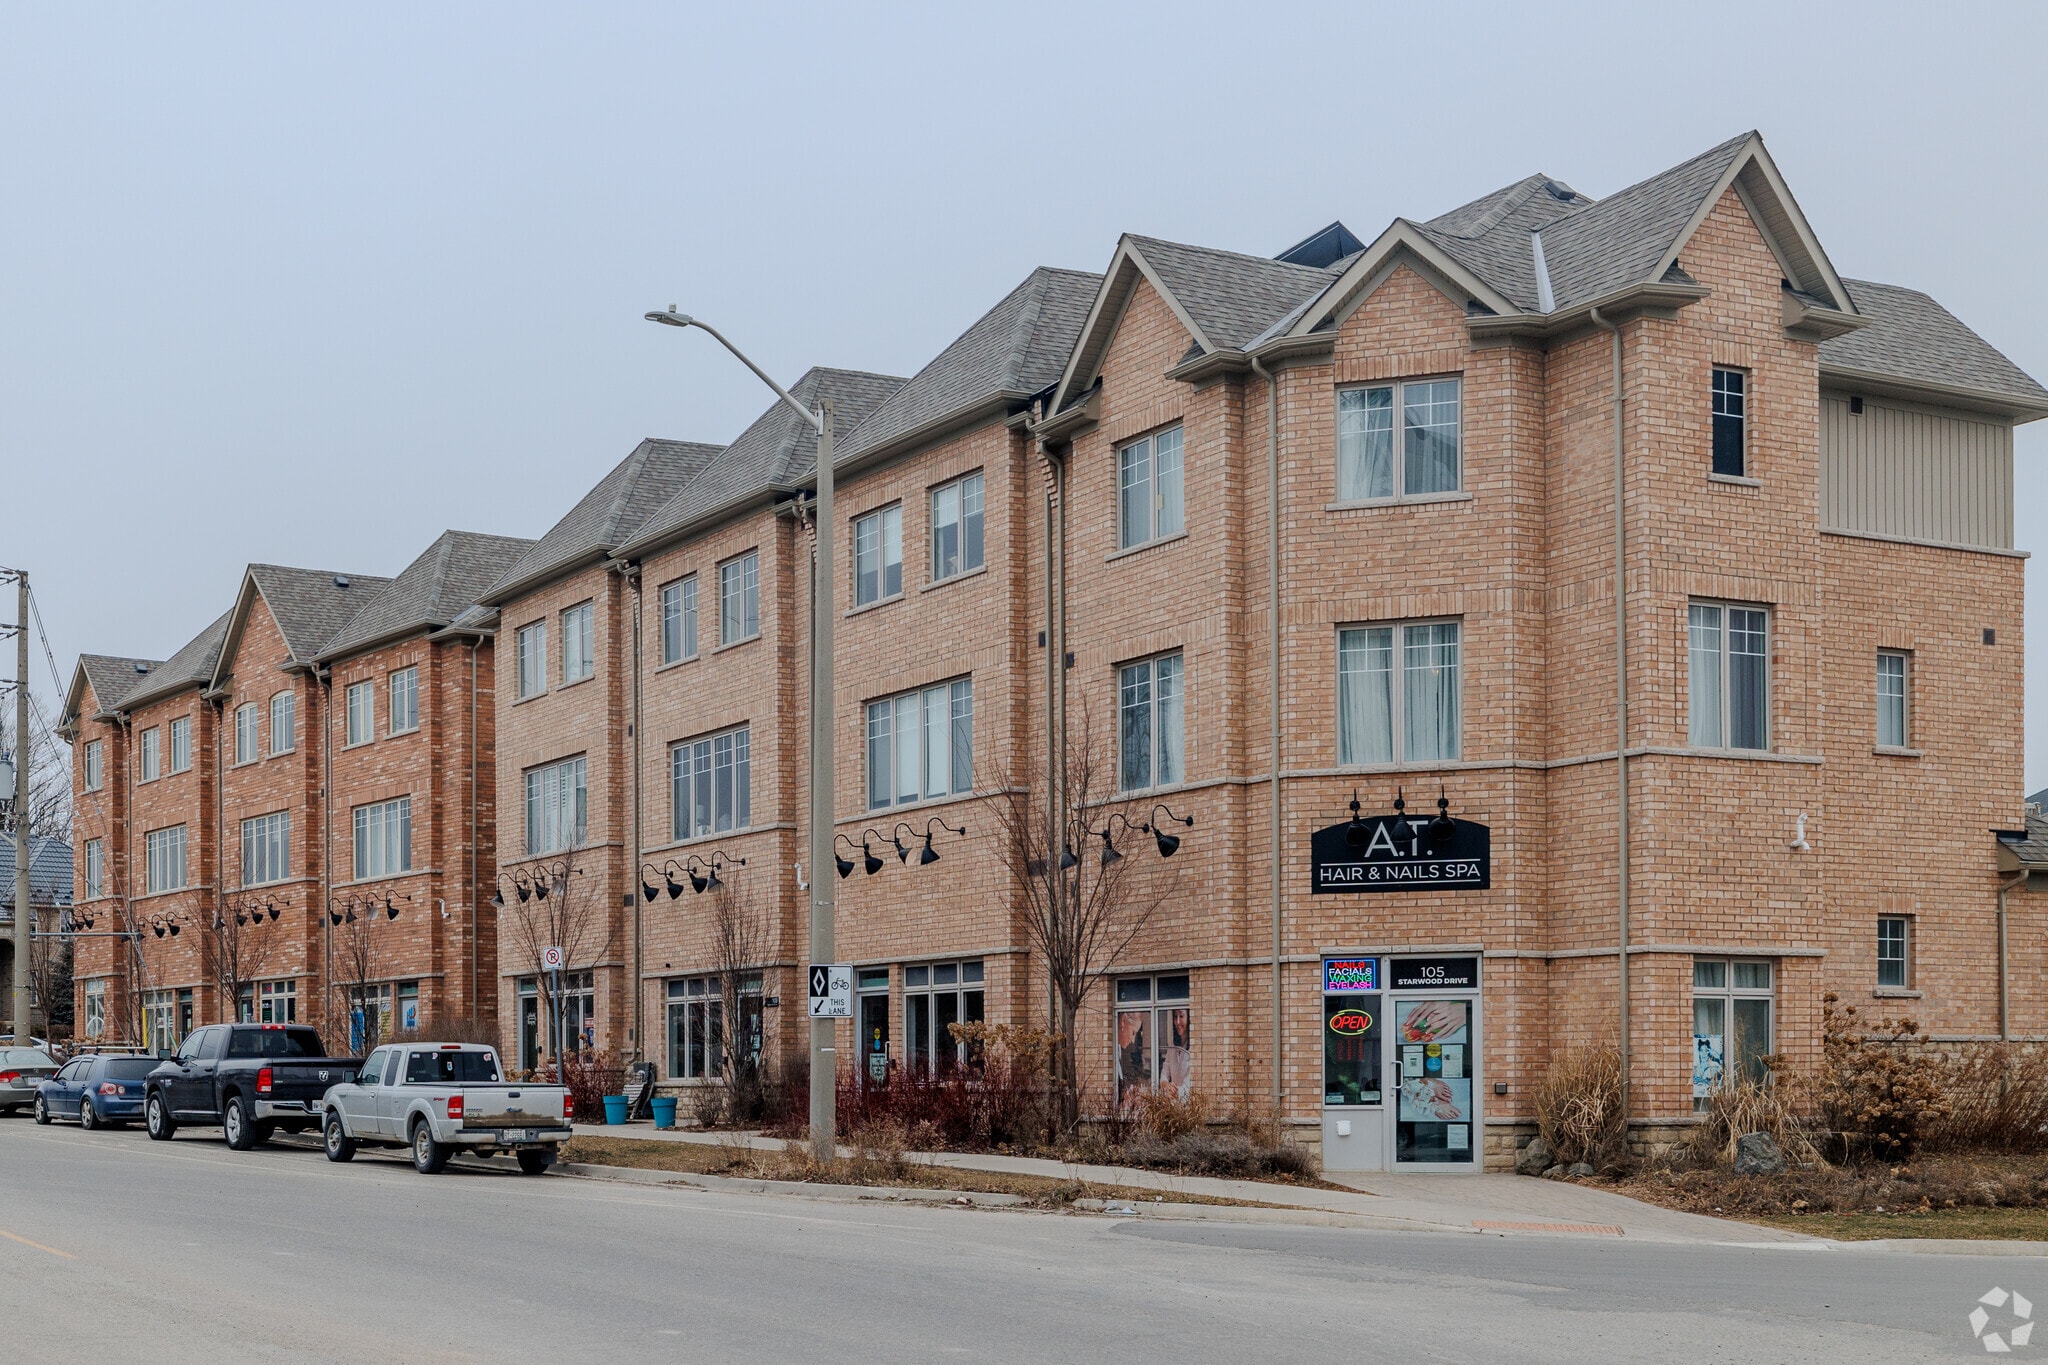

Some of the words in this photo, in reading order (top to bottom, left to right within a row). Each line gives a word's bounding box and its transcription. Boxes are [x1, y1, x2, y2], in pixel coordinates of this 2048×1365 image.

[1320, 867, 1363, 882] HAIR
[1368, 866, 1381, 880] &
[1386, 864, 1439, 879] NAILS
[1445, 863, 1481, 878] SPA
[1334, 961, 1365, 969] NAILS
[1328, 968, 1372, 976] FACIALS
[1420, 966, 1445, 978] 105
[830, 998, 845, 1006] THIS
[828, 1007, 846, 1015] LANE
[1332, 1015, 1369, 1029] OPEN
